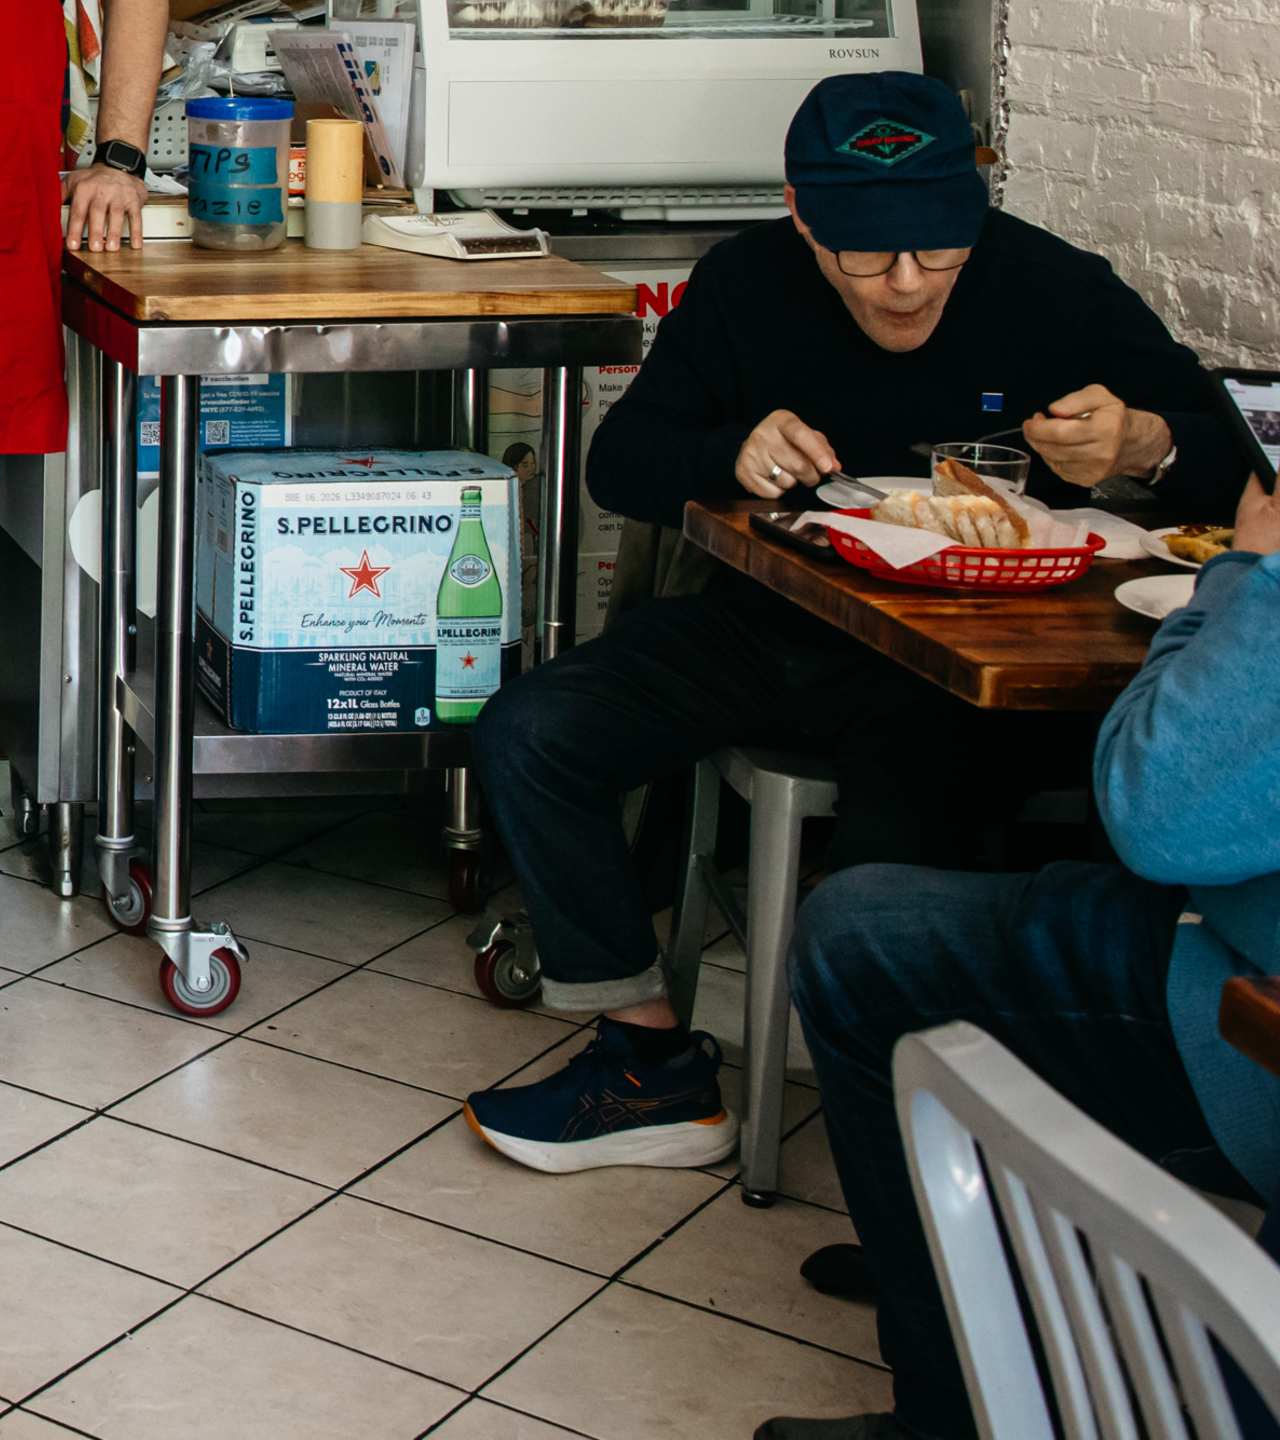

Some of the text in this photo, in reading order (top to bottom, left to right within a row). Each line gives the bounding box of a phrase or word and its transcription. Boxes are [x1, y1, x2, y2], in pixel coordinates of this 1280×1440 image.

[828, 48, 880, 59] ROVSUN
[190, 148, 252, 174] TIPS
[277, 514, 453, 536] S.PELLEGRINO
[239, 490, 256, 642] S.PELLEGRINO
[301, 610, 428, 636] Enhance your Moments
[318, 651, 409, 663] SPARKLING NATURAL
[328, 662, 400, 672] MINERAL WATER
[326, 698, 358, 709] 12x1L
